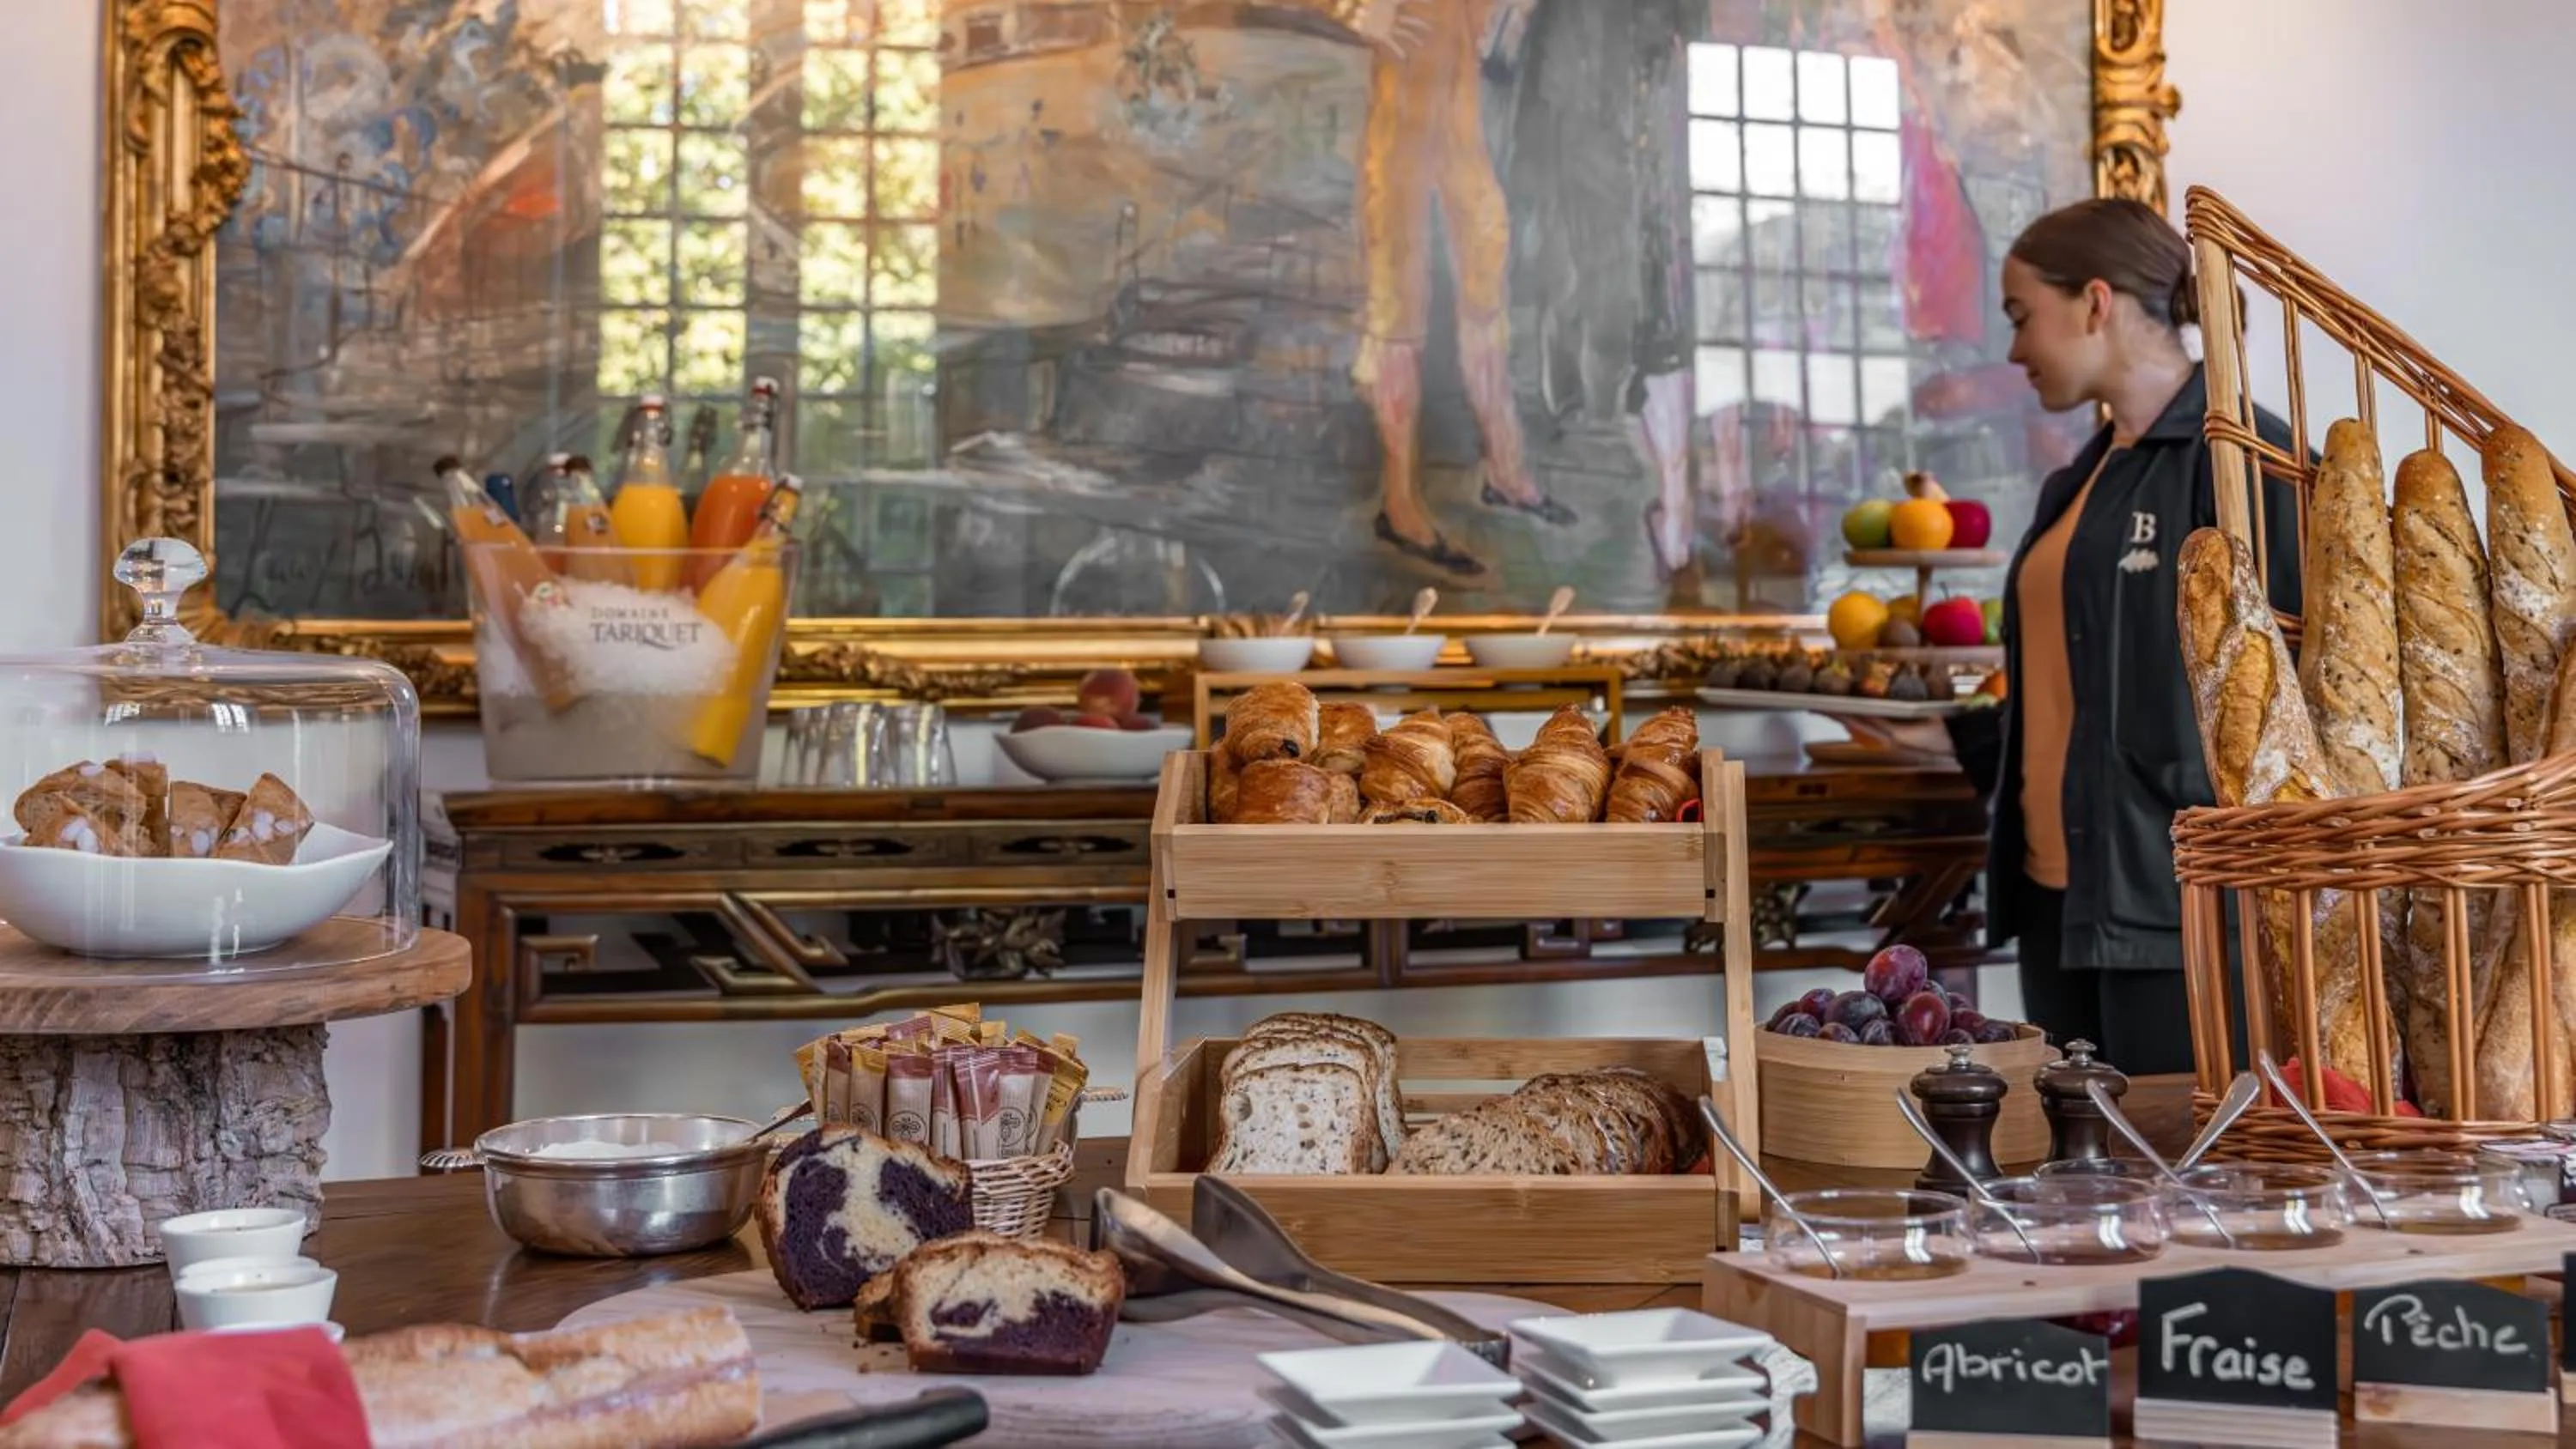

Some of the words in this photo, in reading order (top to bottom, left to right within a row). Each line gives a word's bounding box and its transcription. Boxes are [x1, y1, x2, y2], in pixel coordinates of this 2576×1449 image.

[2130, 511, 2157, 544] B
[589, 621, 703, 651] TARIQUET
[2161, 1301, 2316, 1390] Fraise
[2364, 1294, 2528, 1354] Pêche
[1922, 1343, 2109, 1392] Abricot
